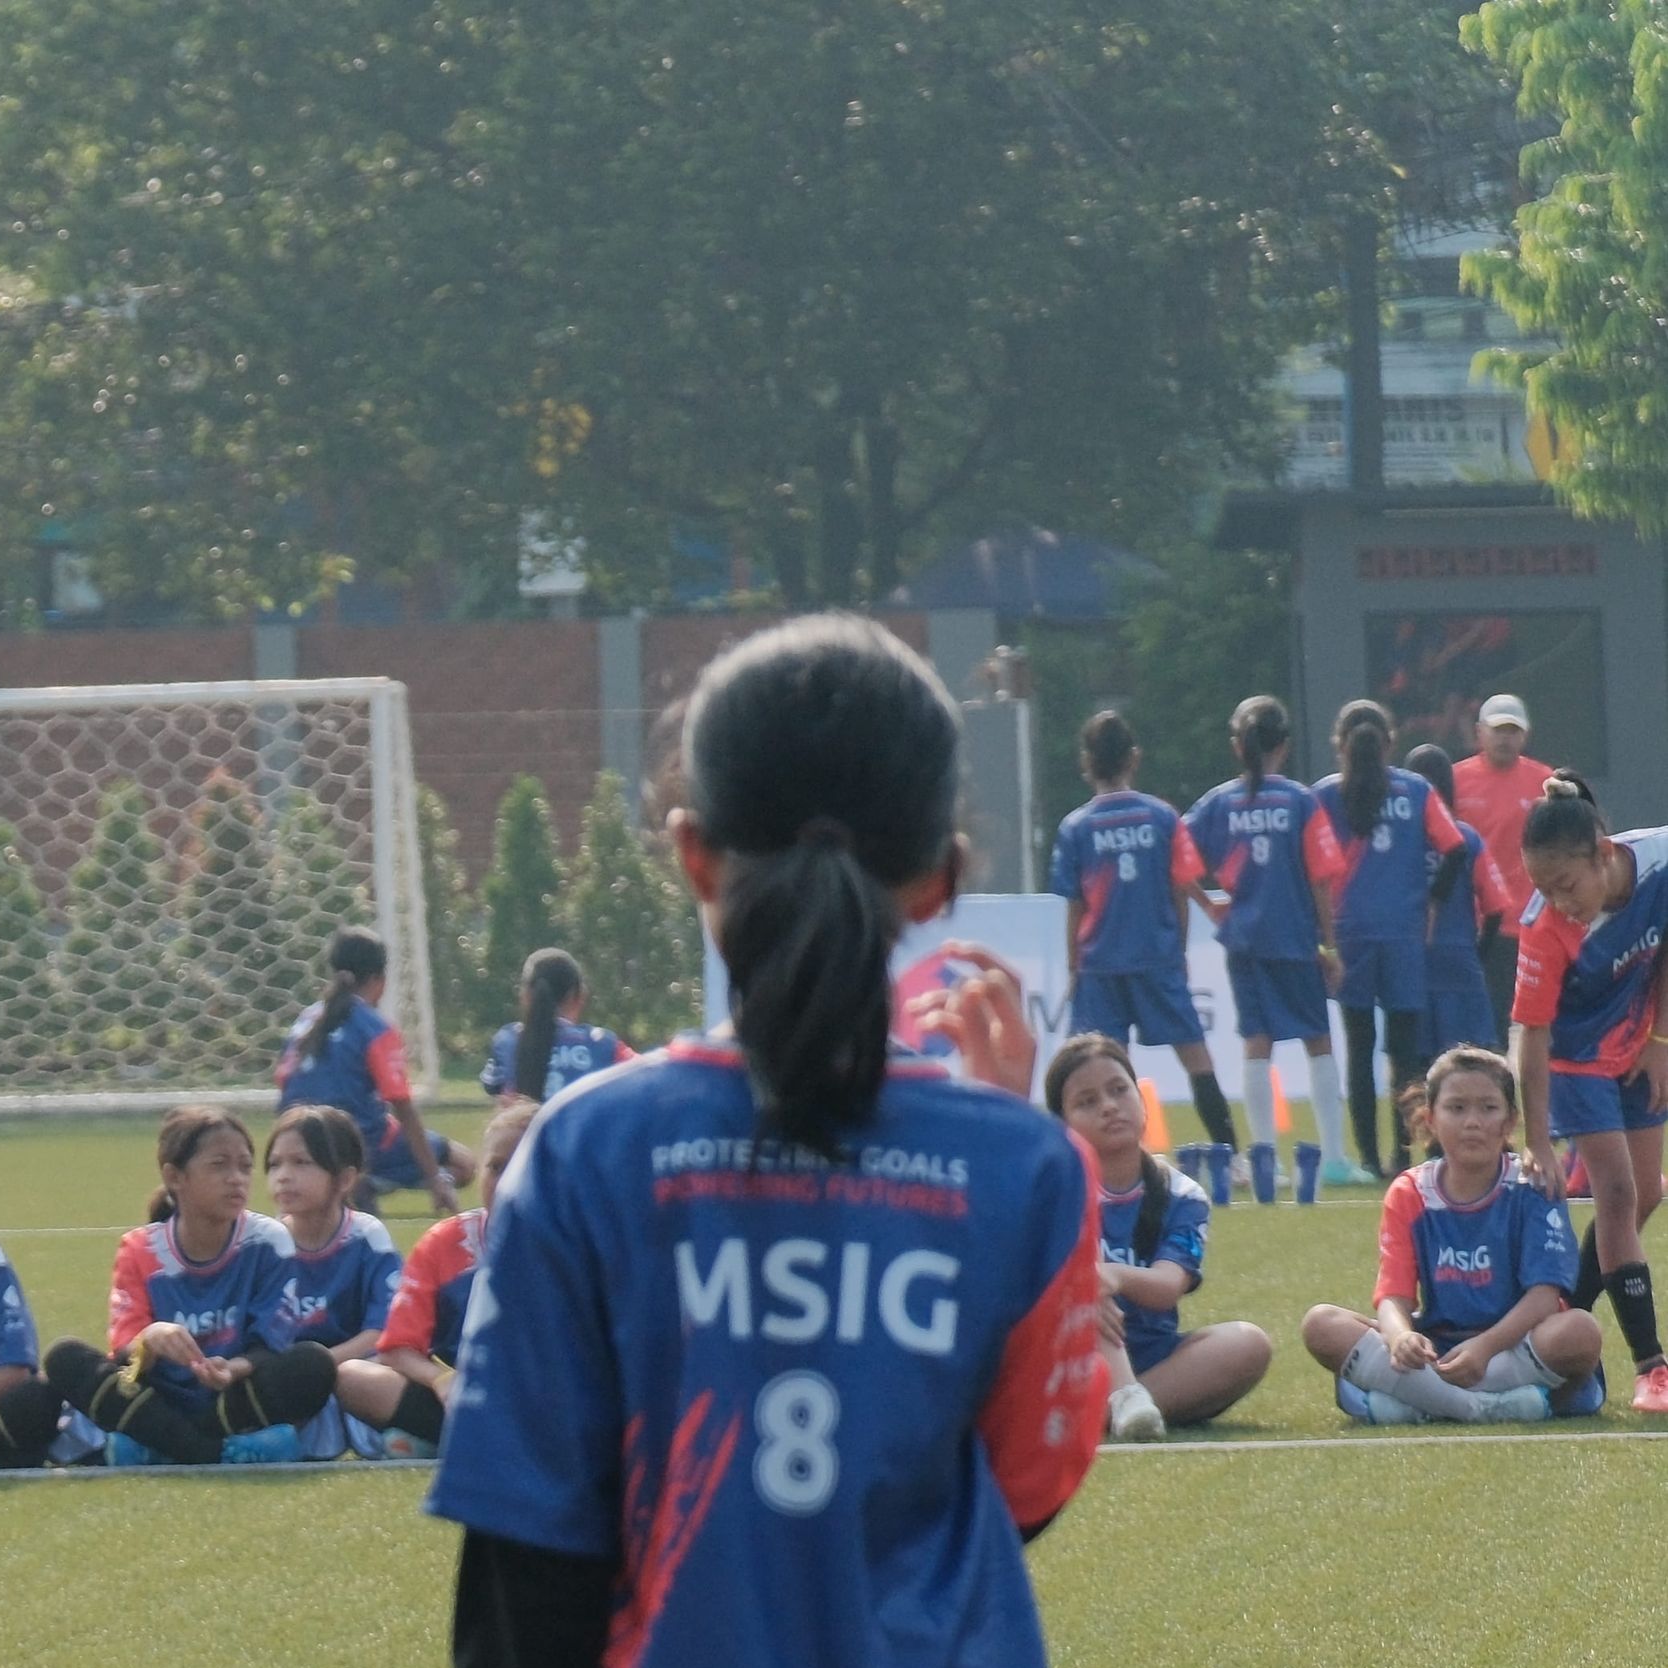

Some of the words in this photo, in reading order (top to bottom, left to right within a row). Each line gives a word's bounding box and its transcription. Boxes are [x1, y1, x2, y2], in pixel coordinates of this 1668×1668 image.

[1229, 807, 1290, 834] MSIG
[1092, 824, 1156, 852] MSIG
[1251, 834, 1272, 866] 8
[1118, 853, 1139, 882] 8
[1436, 1244, 1492, 1272] MSIG
[674, 1237, 961, 1358] MSIG
[753, 1368, 843, 1518] 8
